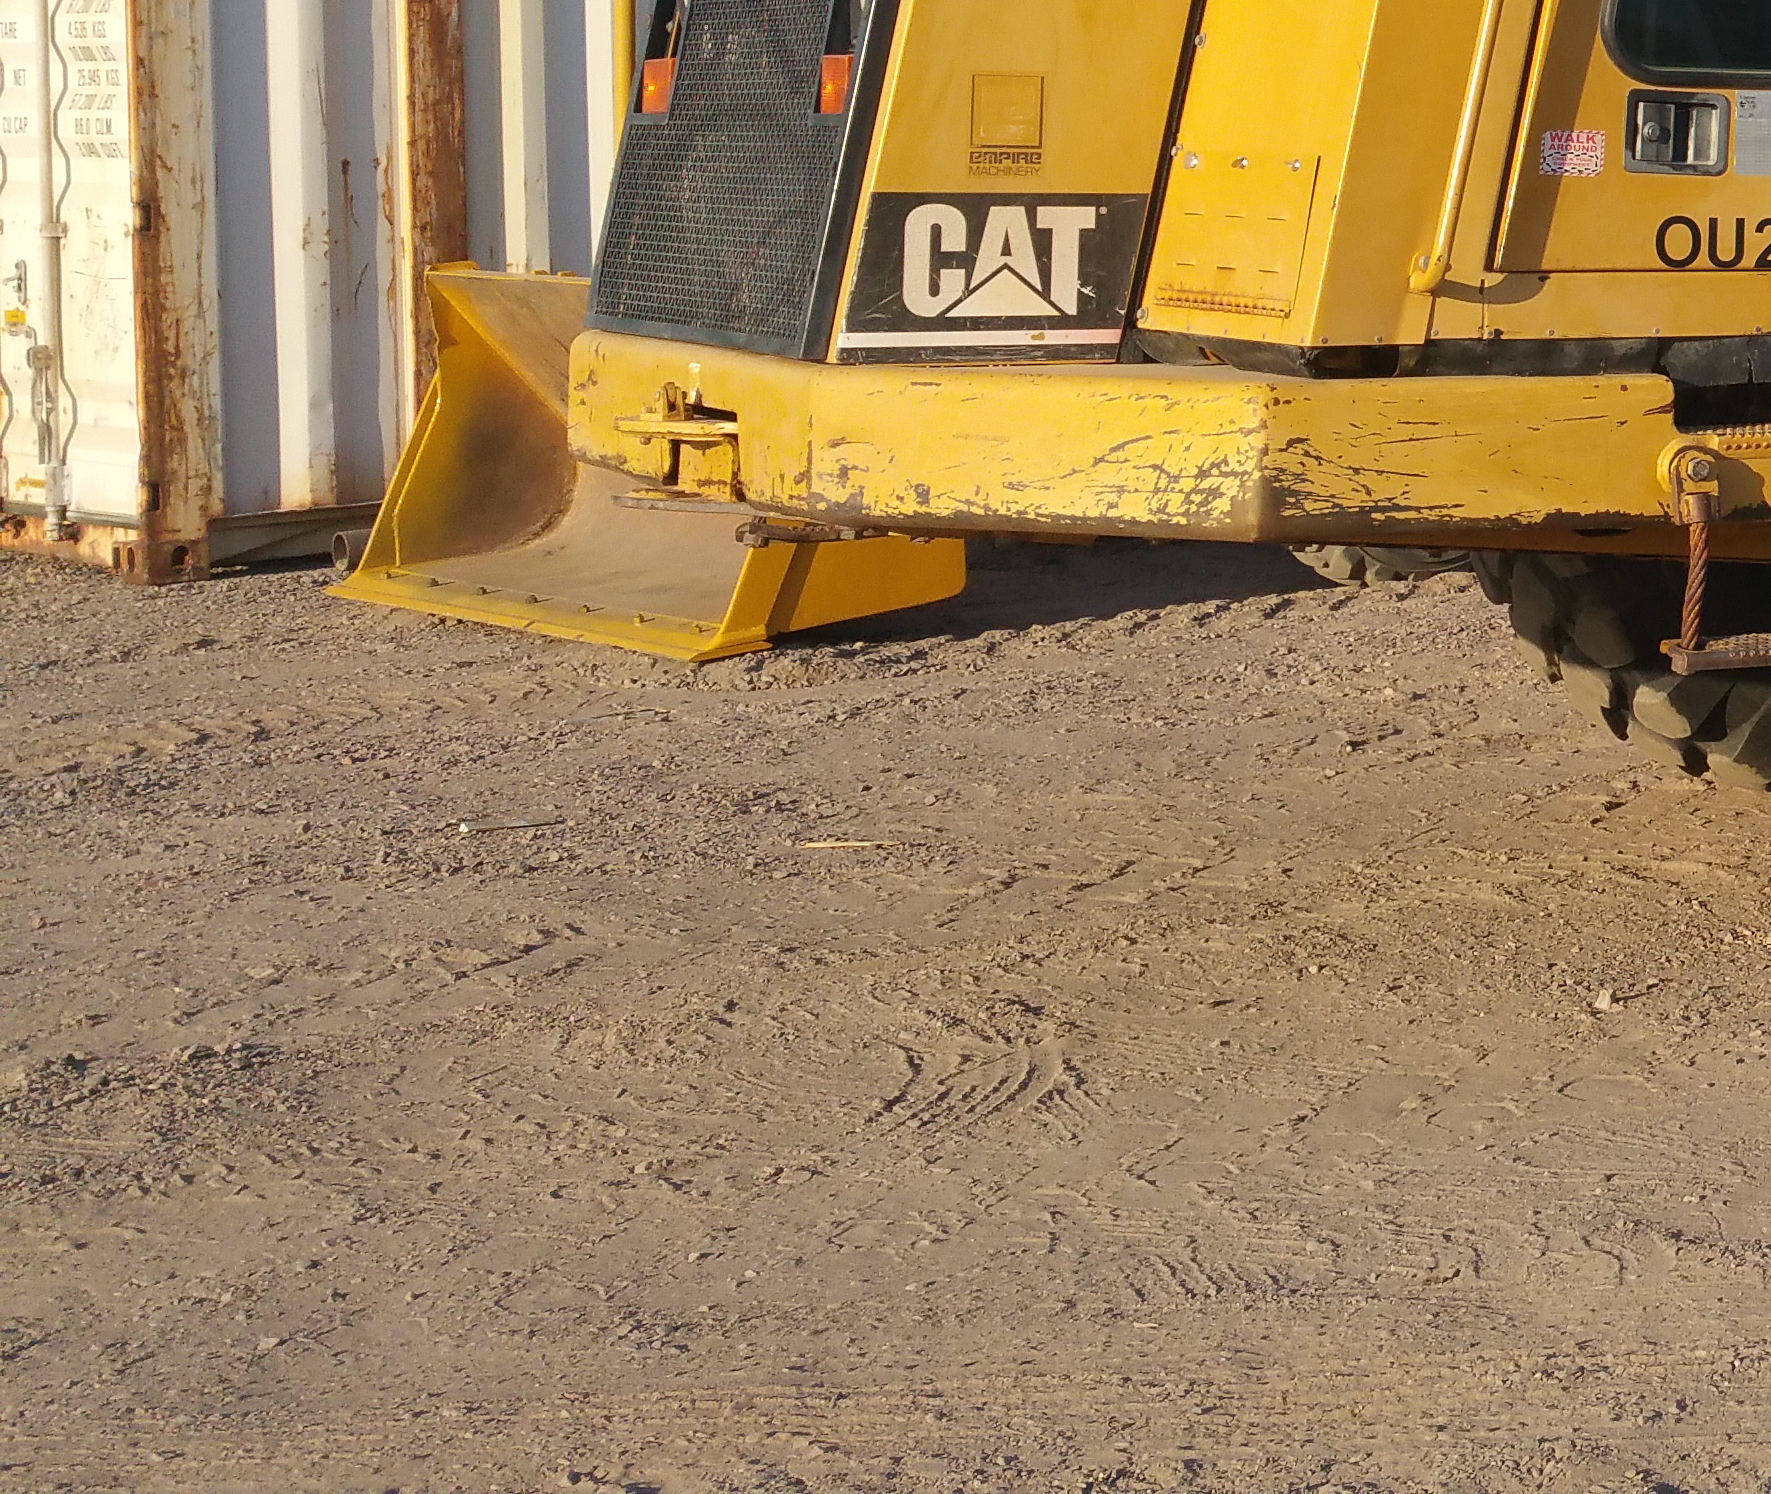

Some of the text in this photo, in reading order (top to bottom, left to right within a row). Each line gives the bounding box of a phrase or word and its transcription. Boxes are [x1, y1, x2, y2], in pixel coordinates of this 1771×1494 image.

[13, 68, 26, 86] NET
[1549, 131, 1597, 144] WALK
[1548, 143, 1598, 153] AROUND
[968, 165, 1043, 177] MACHINERY
[902, 203, 1097, 318] CAT
